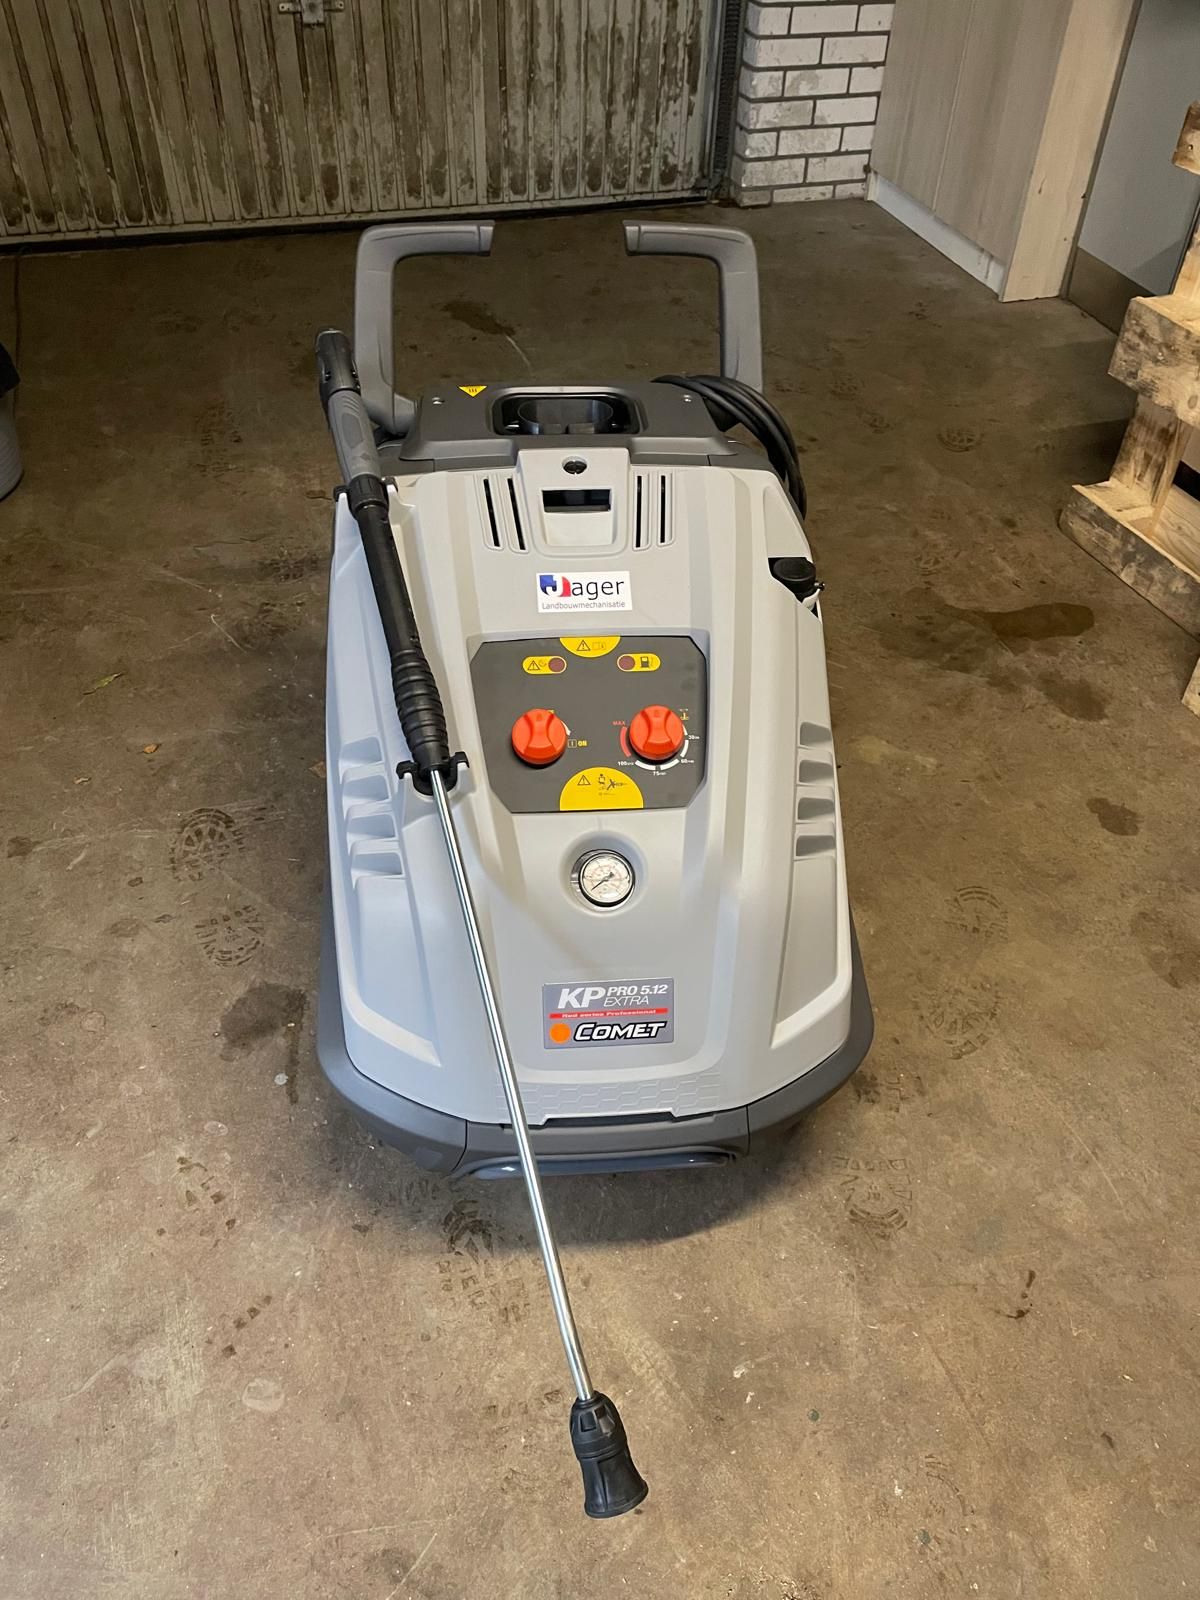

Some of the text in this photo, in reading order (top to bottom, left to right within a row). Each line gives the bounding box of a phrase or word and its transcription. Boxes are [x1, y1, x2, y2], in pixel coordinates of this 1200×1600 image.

[542, 601, 625, 610] Landbouwmechanisatie
[606, 984, 669, 997] PRO 5.12
[557, 987, 606, 1009] KP
[603, 995, 650, 1007] EXTRA
[573, 1021, 668, 1042] COMET
